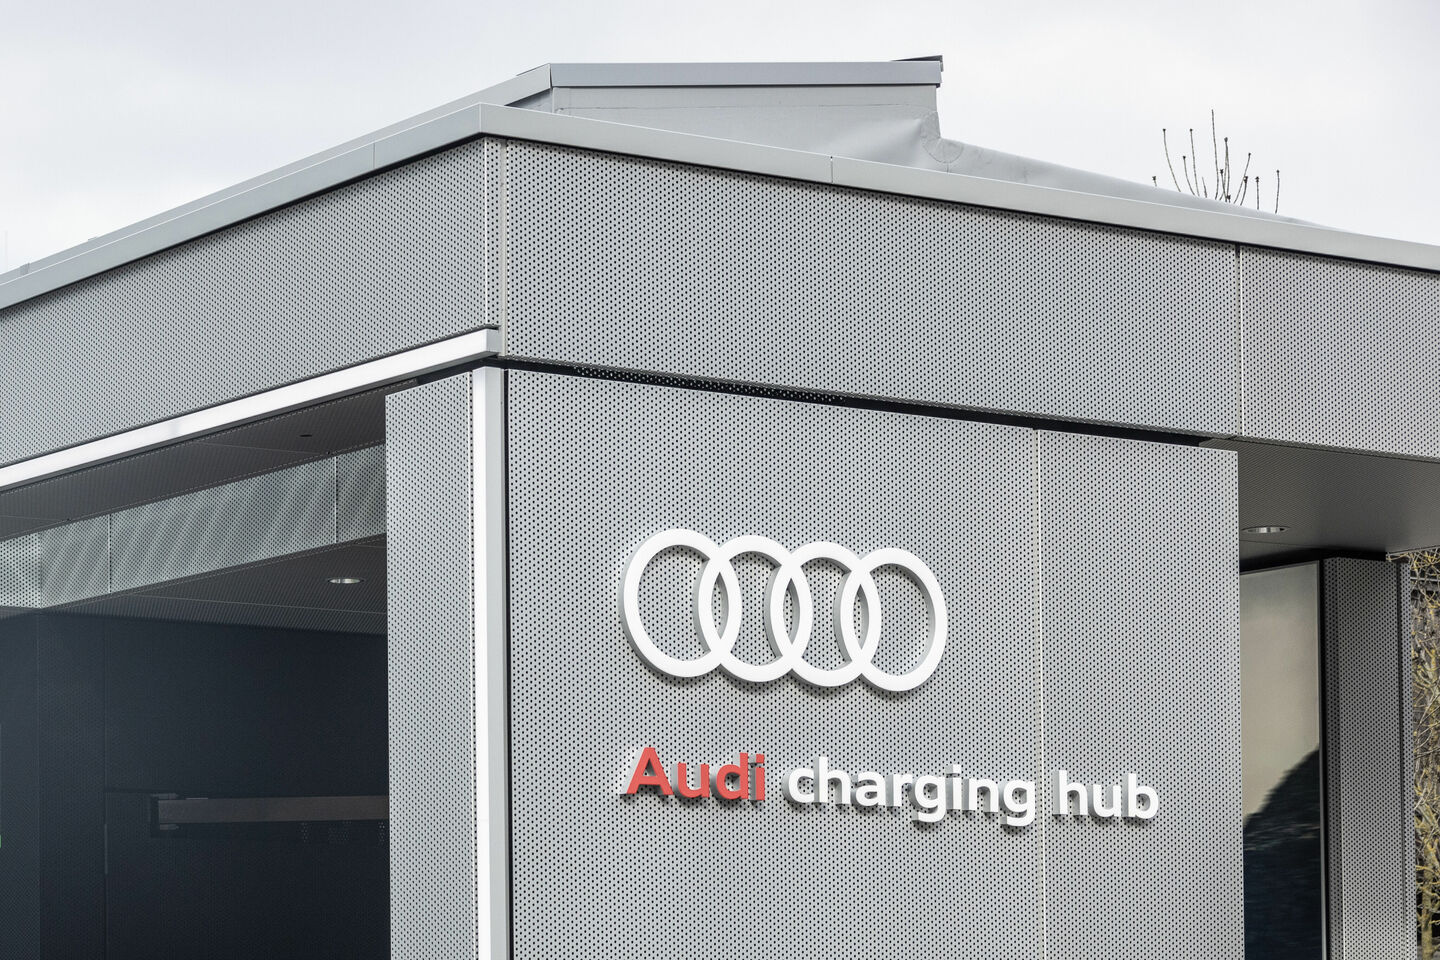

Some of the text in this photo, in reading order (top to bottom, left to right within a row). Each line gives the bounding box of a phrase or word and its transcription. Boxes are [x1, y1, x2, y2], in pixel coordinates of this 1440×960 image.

[622, 746, 1160, 828] Audi charging hub
